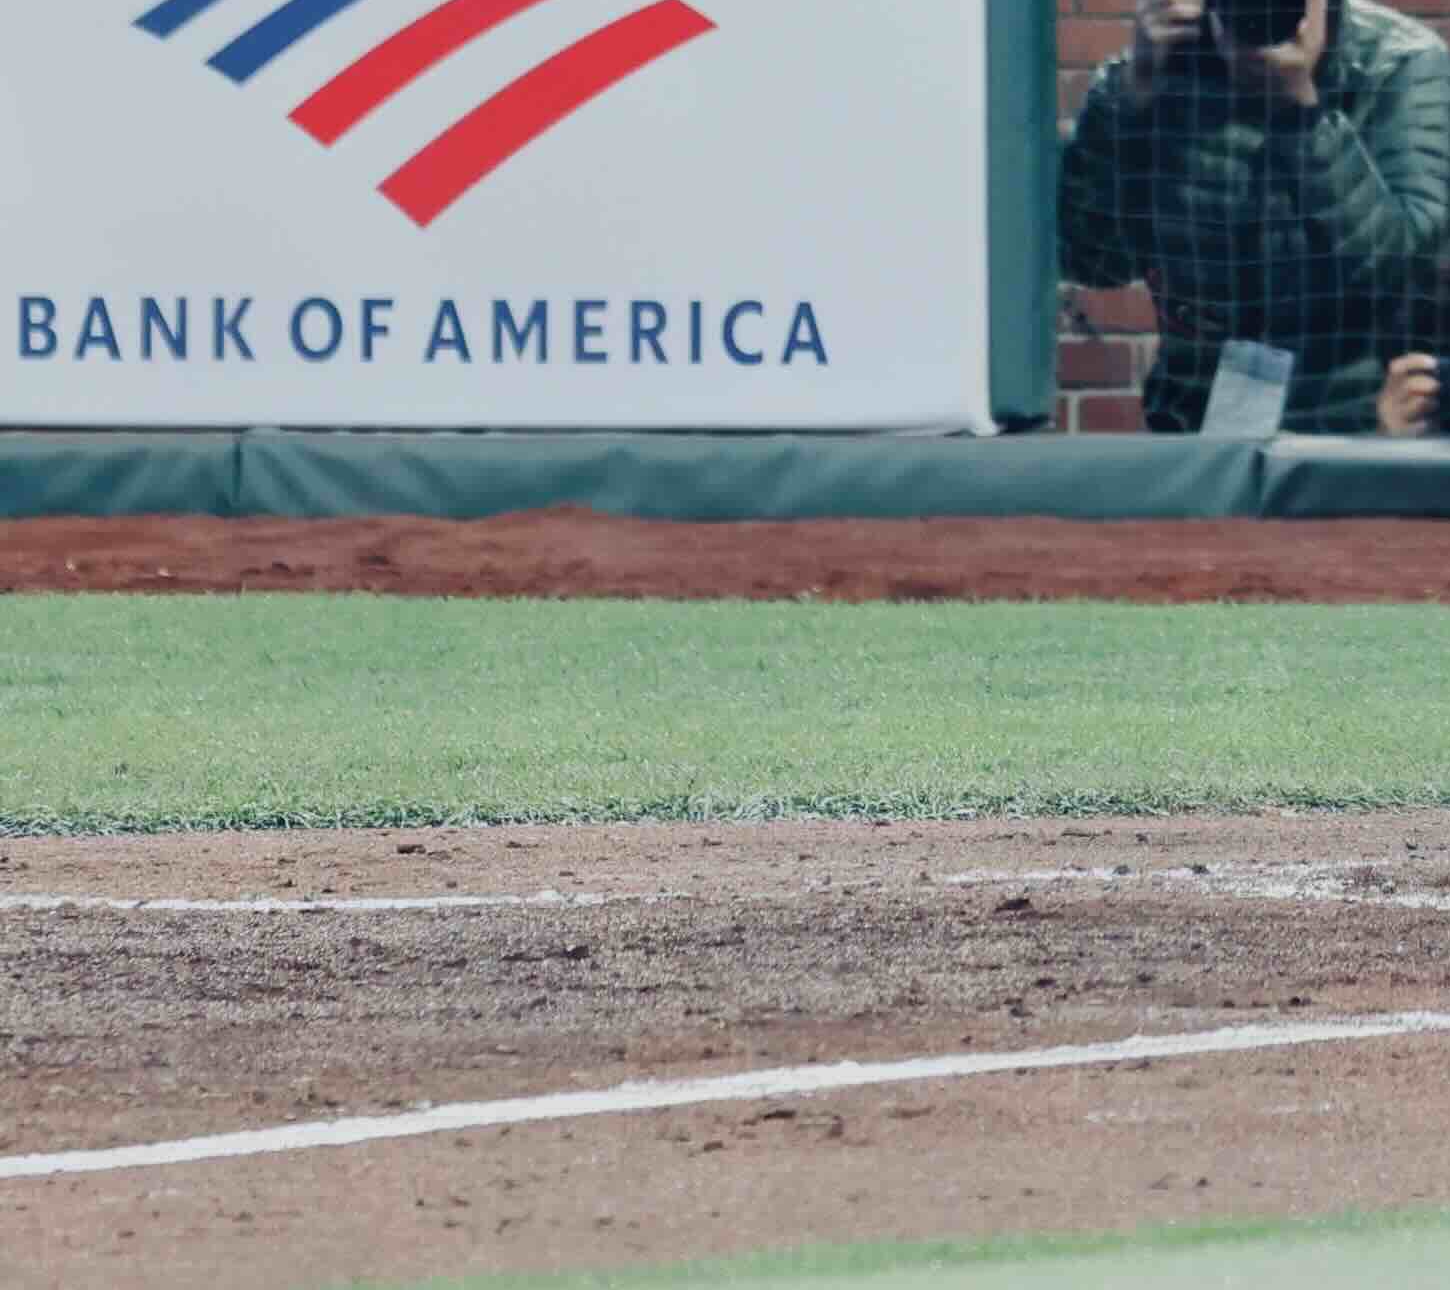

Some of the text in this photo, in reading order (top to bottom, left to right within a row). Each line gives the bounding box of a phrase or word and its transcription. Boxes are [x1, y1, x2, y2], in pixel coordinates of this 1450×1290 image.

[18, 296, 829, 366] BANK OF AMERICA
